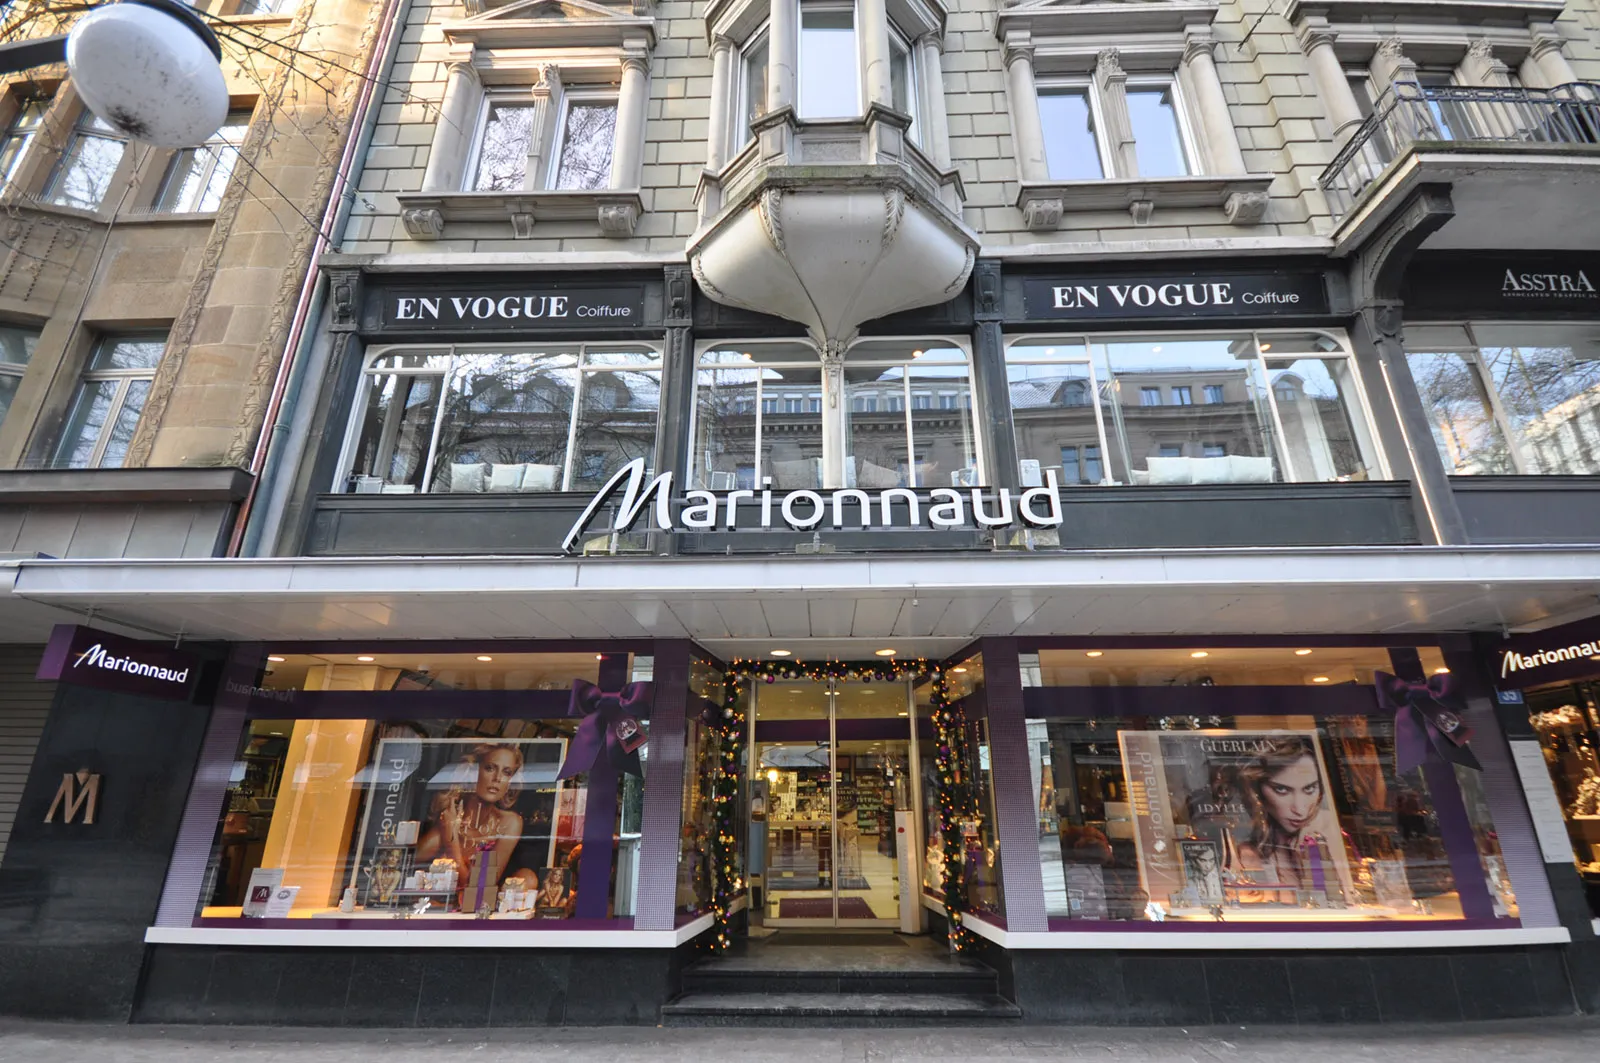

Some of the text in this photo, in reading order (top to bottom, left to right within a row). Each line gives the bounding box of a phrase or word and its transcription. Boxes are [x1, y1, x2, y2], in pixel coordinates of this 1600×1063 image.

[395, 296, 631, 320] EN VOGUE Coiffure
[1052, 282, 1300, 309] EN VOGUE Coiffure
[561, 457, 1064, 553] Marionnaud
[73, 643, 189, 683] Marionnaud
[1501, 640, 1600, 679] Marionnau
[375, 758, 405, 845] rionnaud
[1136, 750, 1179, 883] Mrionnaud
